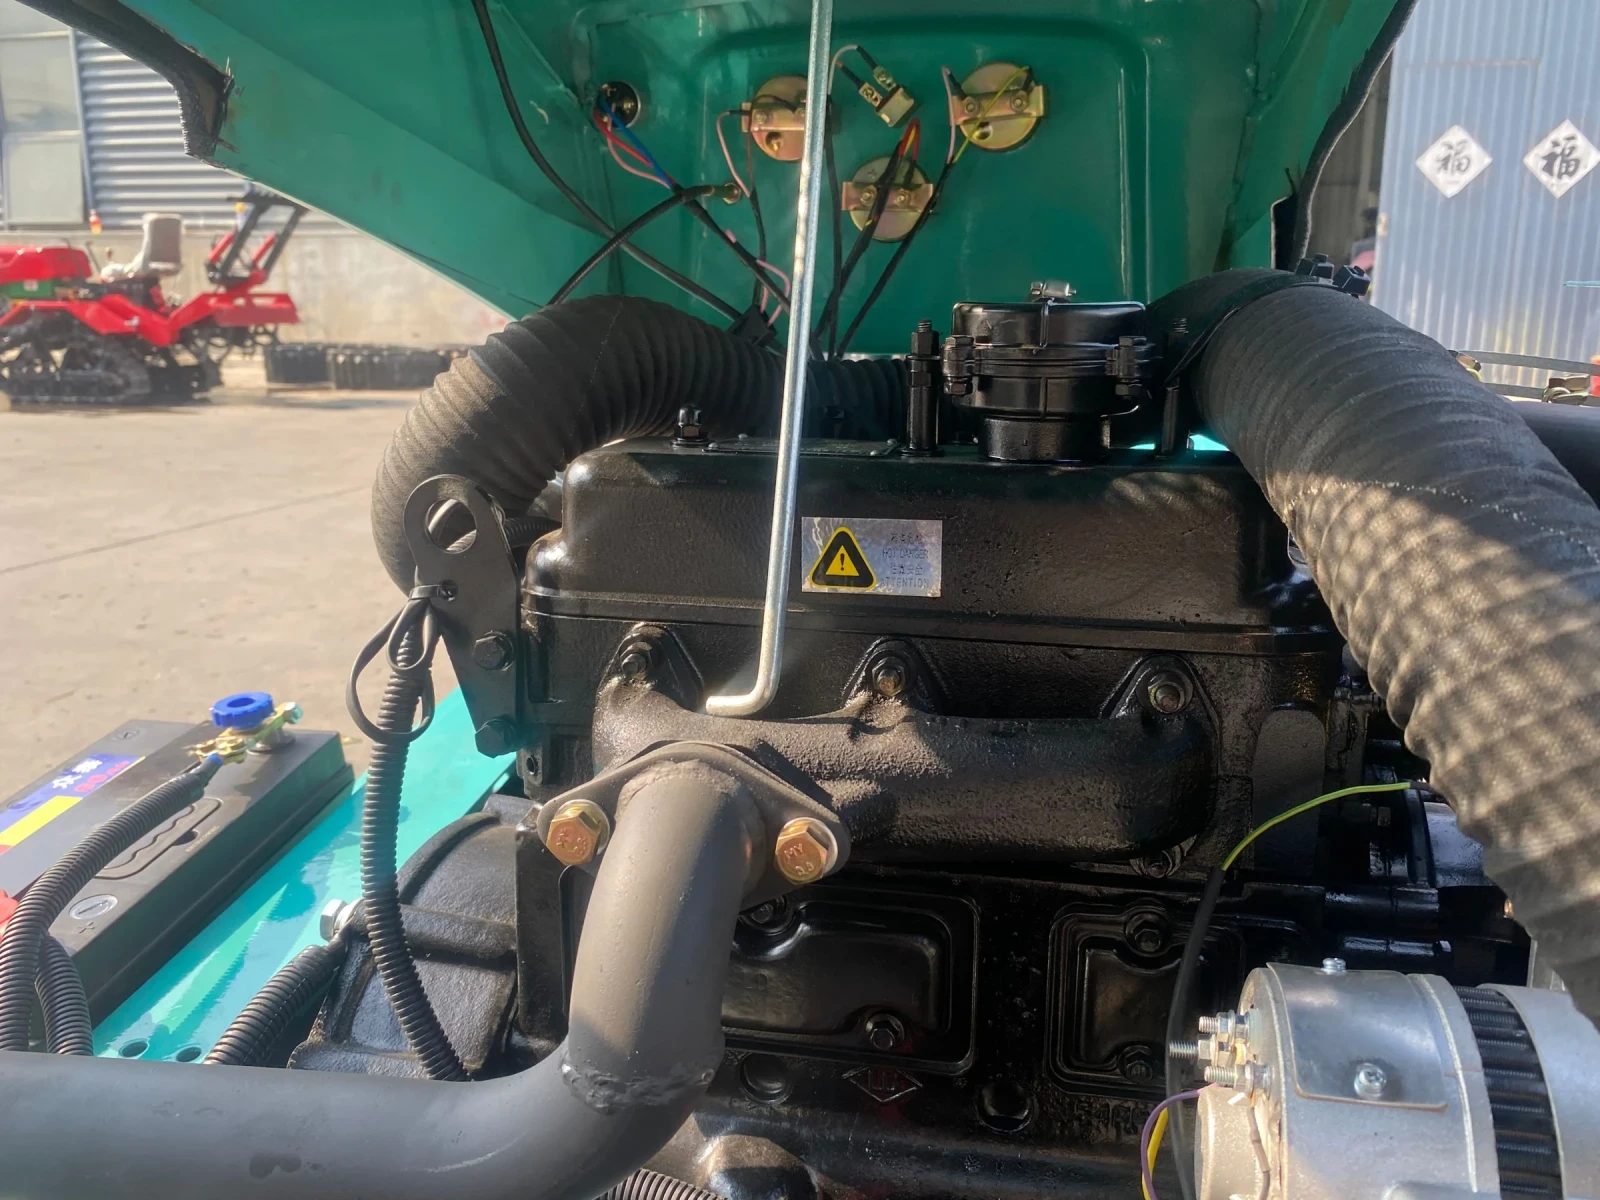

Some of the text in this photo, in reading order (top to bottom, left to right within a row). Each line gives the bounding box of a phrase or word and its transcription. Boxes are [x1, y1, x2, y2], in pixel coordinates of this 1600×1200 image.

[1436, 140, 1471, 176] 福
[1542, 135, 1581, 179] 福
[882, 547, 929, 560] HOT DANGER
[880, 576, 929, 588] ATTENTION
